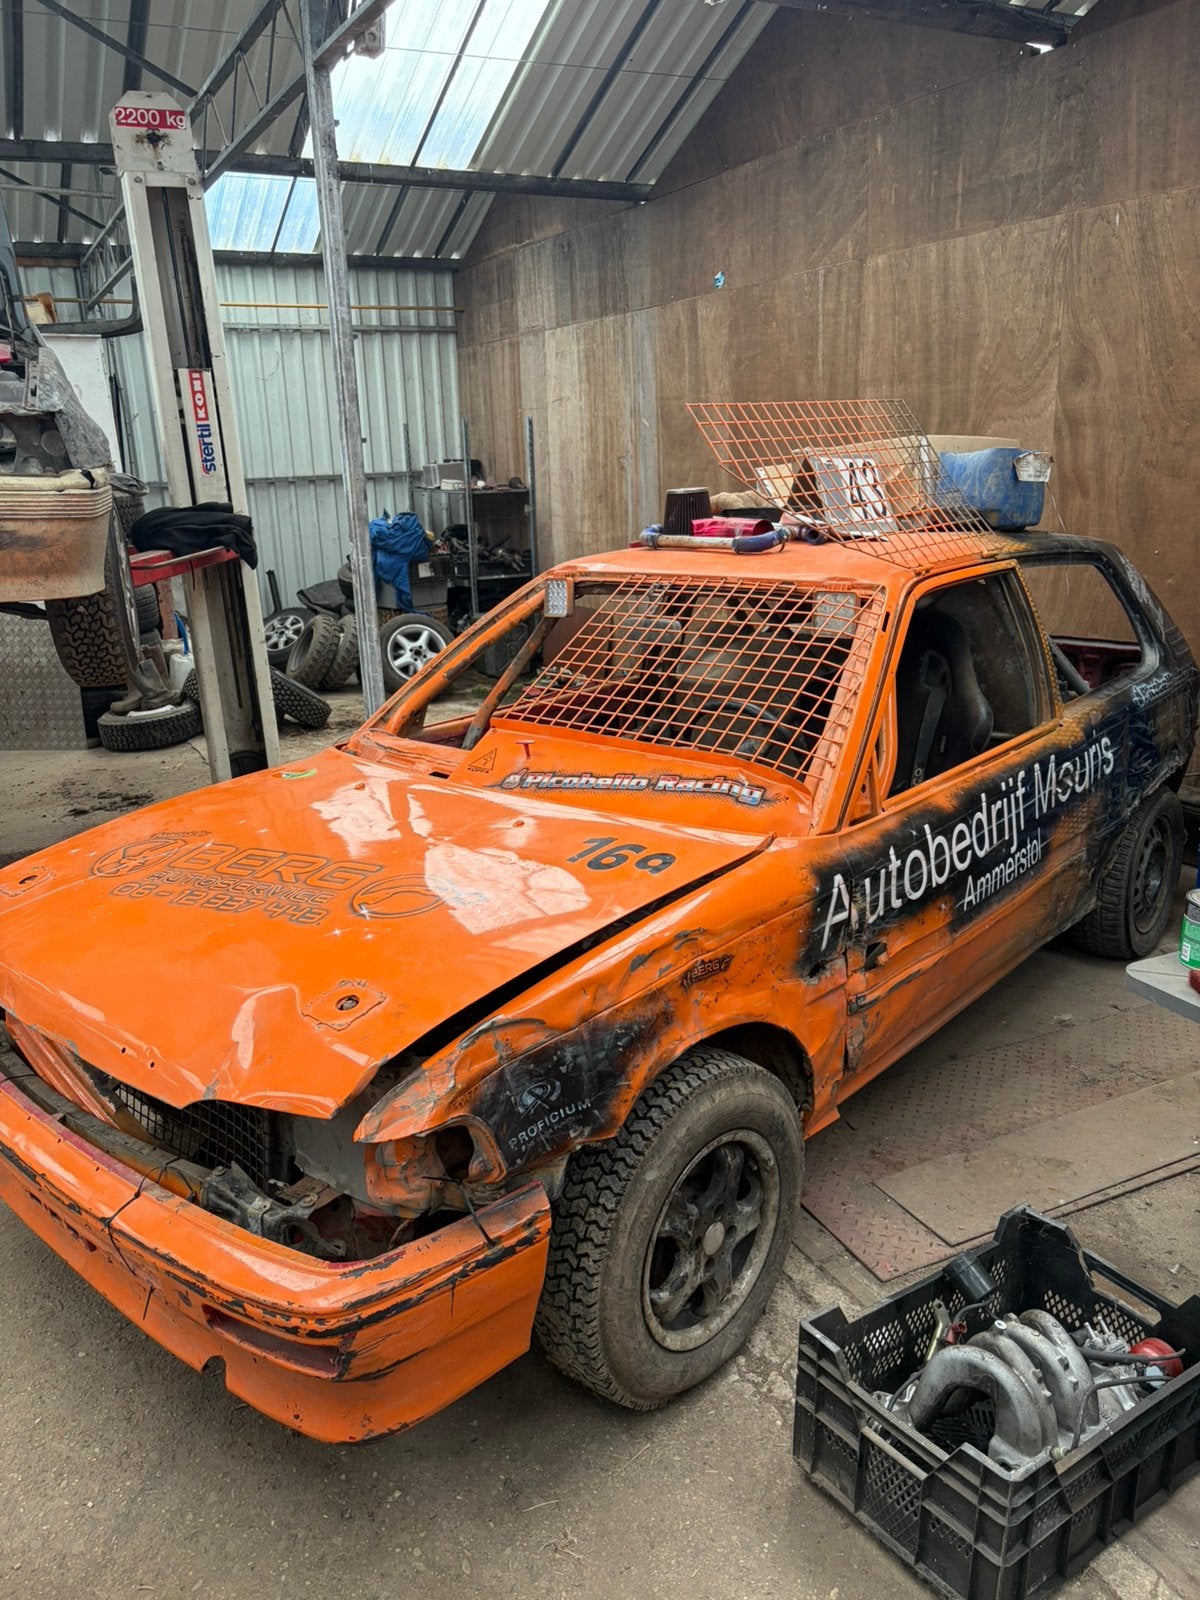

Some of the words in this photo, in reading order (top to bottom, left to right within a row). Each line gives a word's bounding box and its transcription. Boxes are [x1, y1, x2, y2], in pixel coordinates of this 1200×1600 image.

[115, 107, 160, 125] 2200
[166, 110, 186, 130] kg
[192, 372, 206, 418] KONI
[196, 423, 217, 474] stertil
[521, 771, 650, 791] Picobello
[654, 775, 765, 806] Racing
[820, 768, 1026, 952] Autobedrijf
[1032, 731, 1116, 820] Mouris
[146, 869, 338, 906] AUTOSERVICE
[167, 842, 384, 890] BERG
[963, 828, 1043, 912] Ammerstol
[110, 881, 160, 898] 06
[691, 959, 720, 978] BERG
[508, 1098, 592, 1151] PROFICIUM
